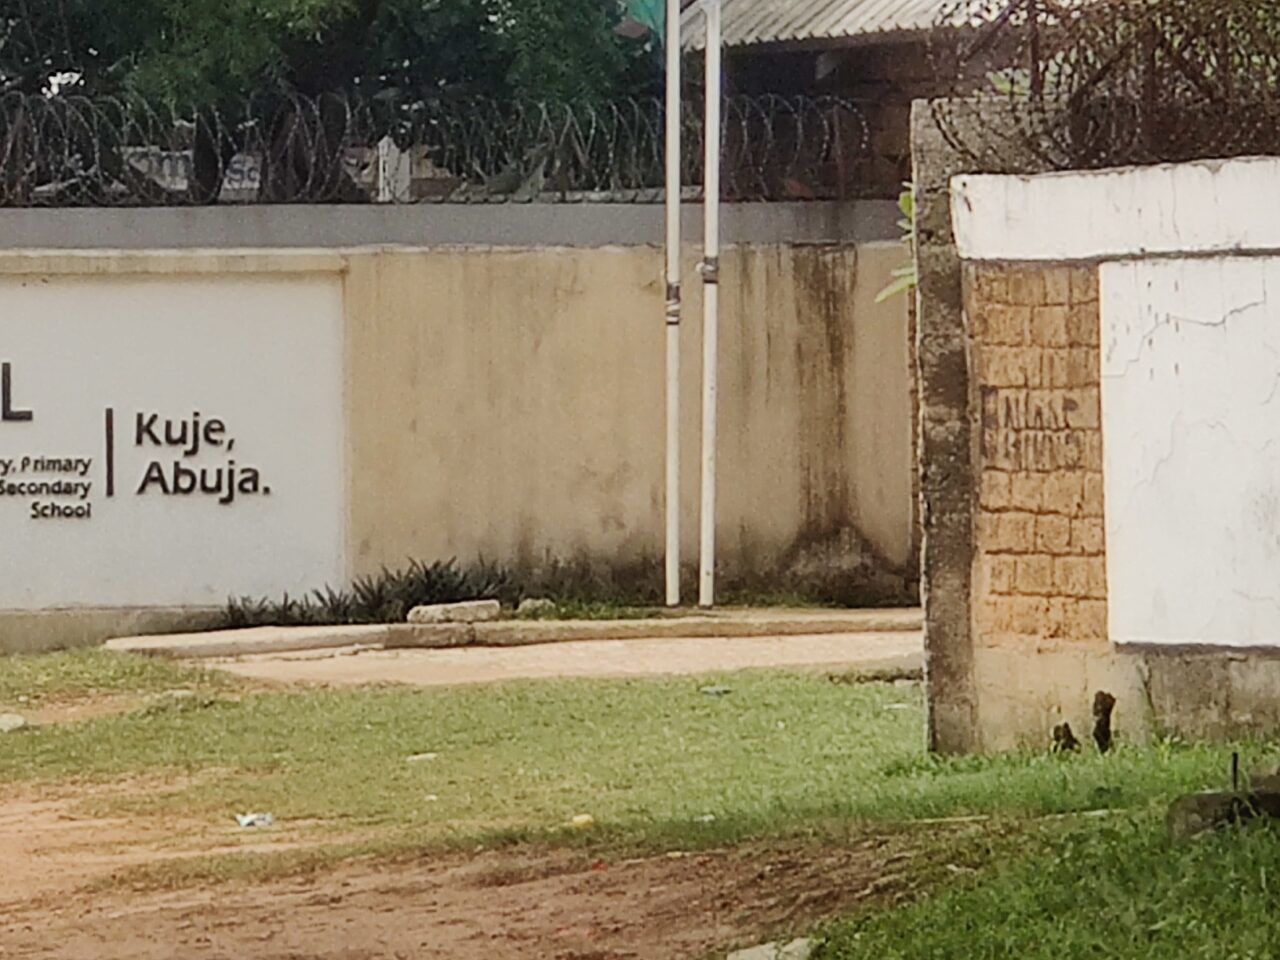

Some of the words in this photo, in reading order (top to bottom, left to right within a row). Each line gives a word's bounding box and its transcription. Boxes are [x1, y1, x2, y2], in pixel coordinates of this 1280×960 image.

[135, 411, 236, 457] Kuje,
[21, 456, 93, 476] Primary
[136, 460, 272, 504] Abuja.
[30, 501, 92, 520] School
